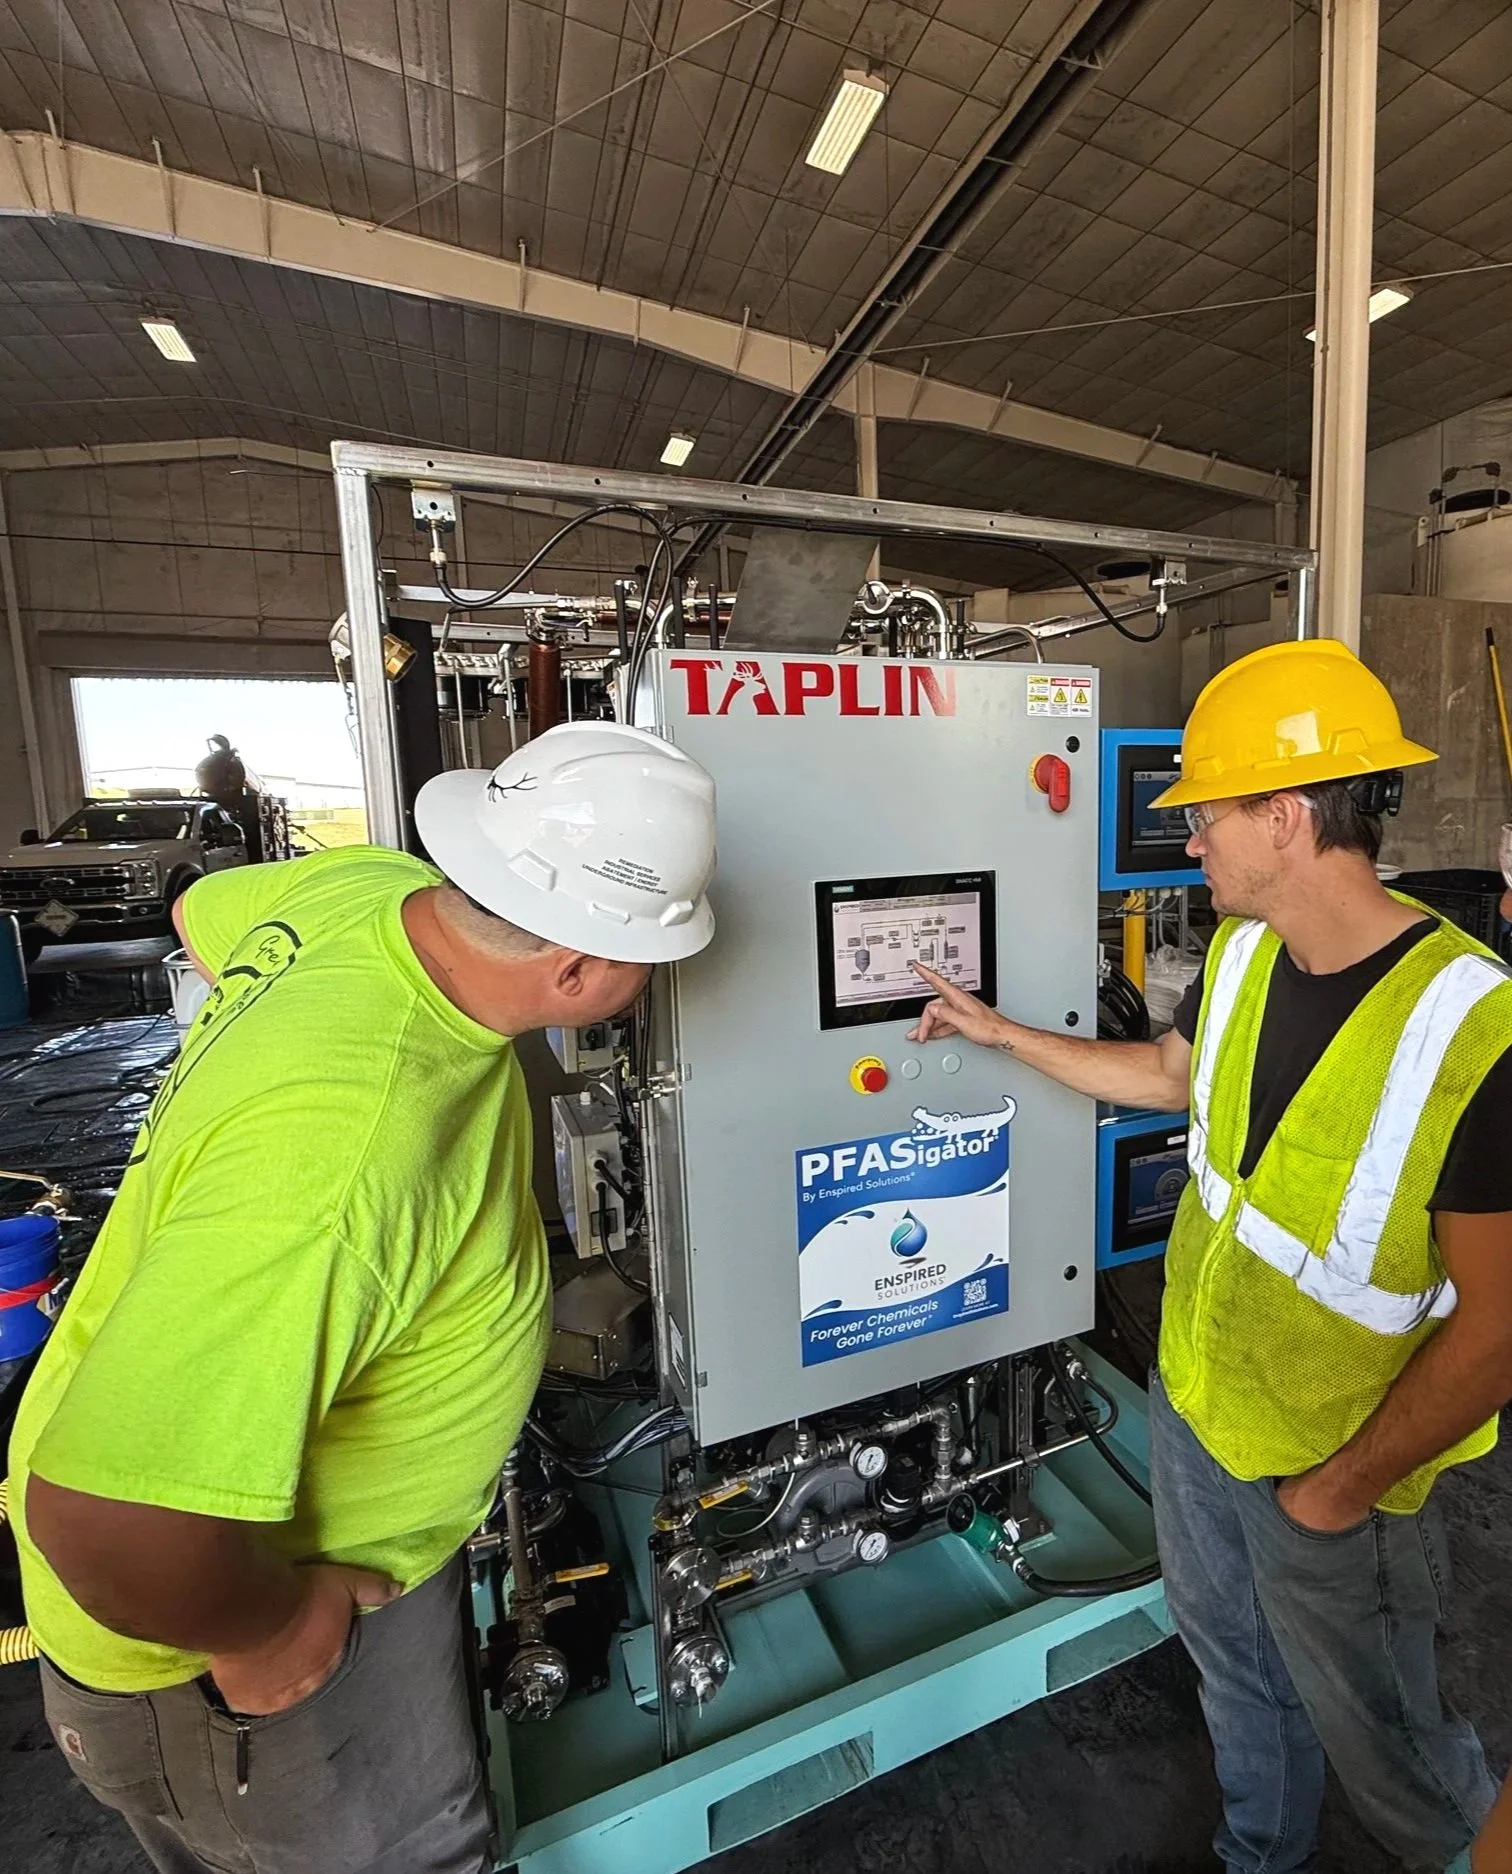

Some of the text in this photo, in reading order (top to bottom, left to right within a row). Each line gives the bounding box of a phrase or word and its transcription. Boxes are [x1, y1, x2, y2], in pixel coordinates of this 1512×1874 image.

[669, 658, 957, 717] TAPLIN
[601, 866, 634, 880] ABATEMENT
[604, 860, 661, 882] INDUSTRIAL SERVICES
[619, 858, 654, 873] REMEDIATION
[582, 864, 668, 895] UNDERGROUND INFRASTRUCTURE
[802, 1191, 816, 1203] By
[819, 1182, 864, 1199] Enspired
[874, 1263, 947, 1291] ENSPIRED
[877, 1277, 945, 1301] SOLUTIONS
[810, 1319, 864, 1343] Forever
[867, 1300, 939, 1328] Chemicals
[836, 1316, 927, 1350] Gone Forever
